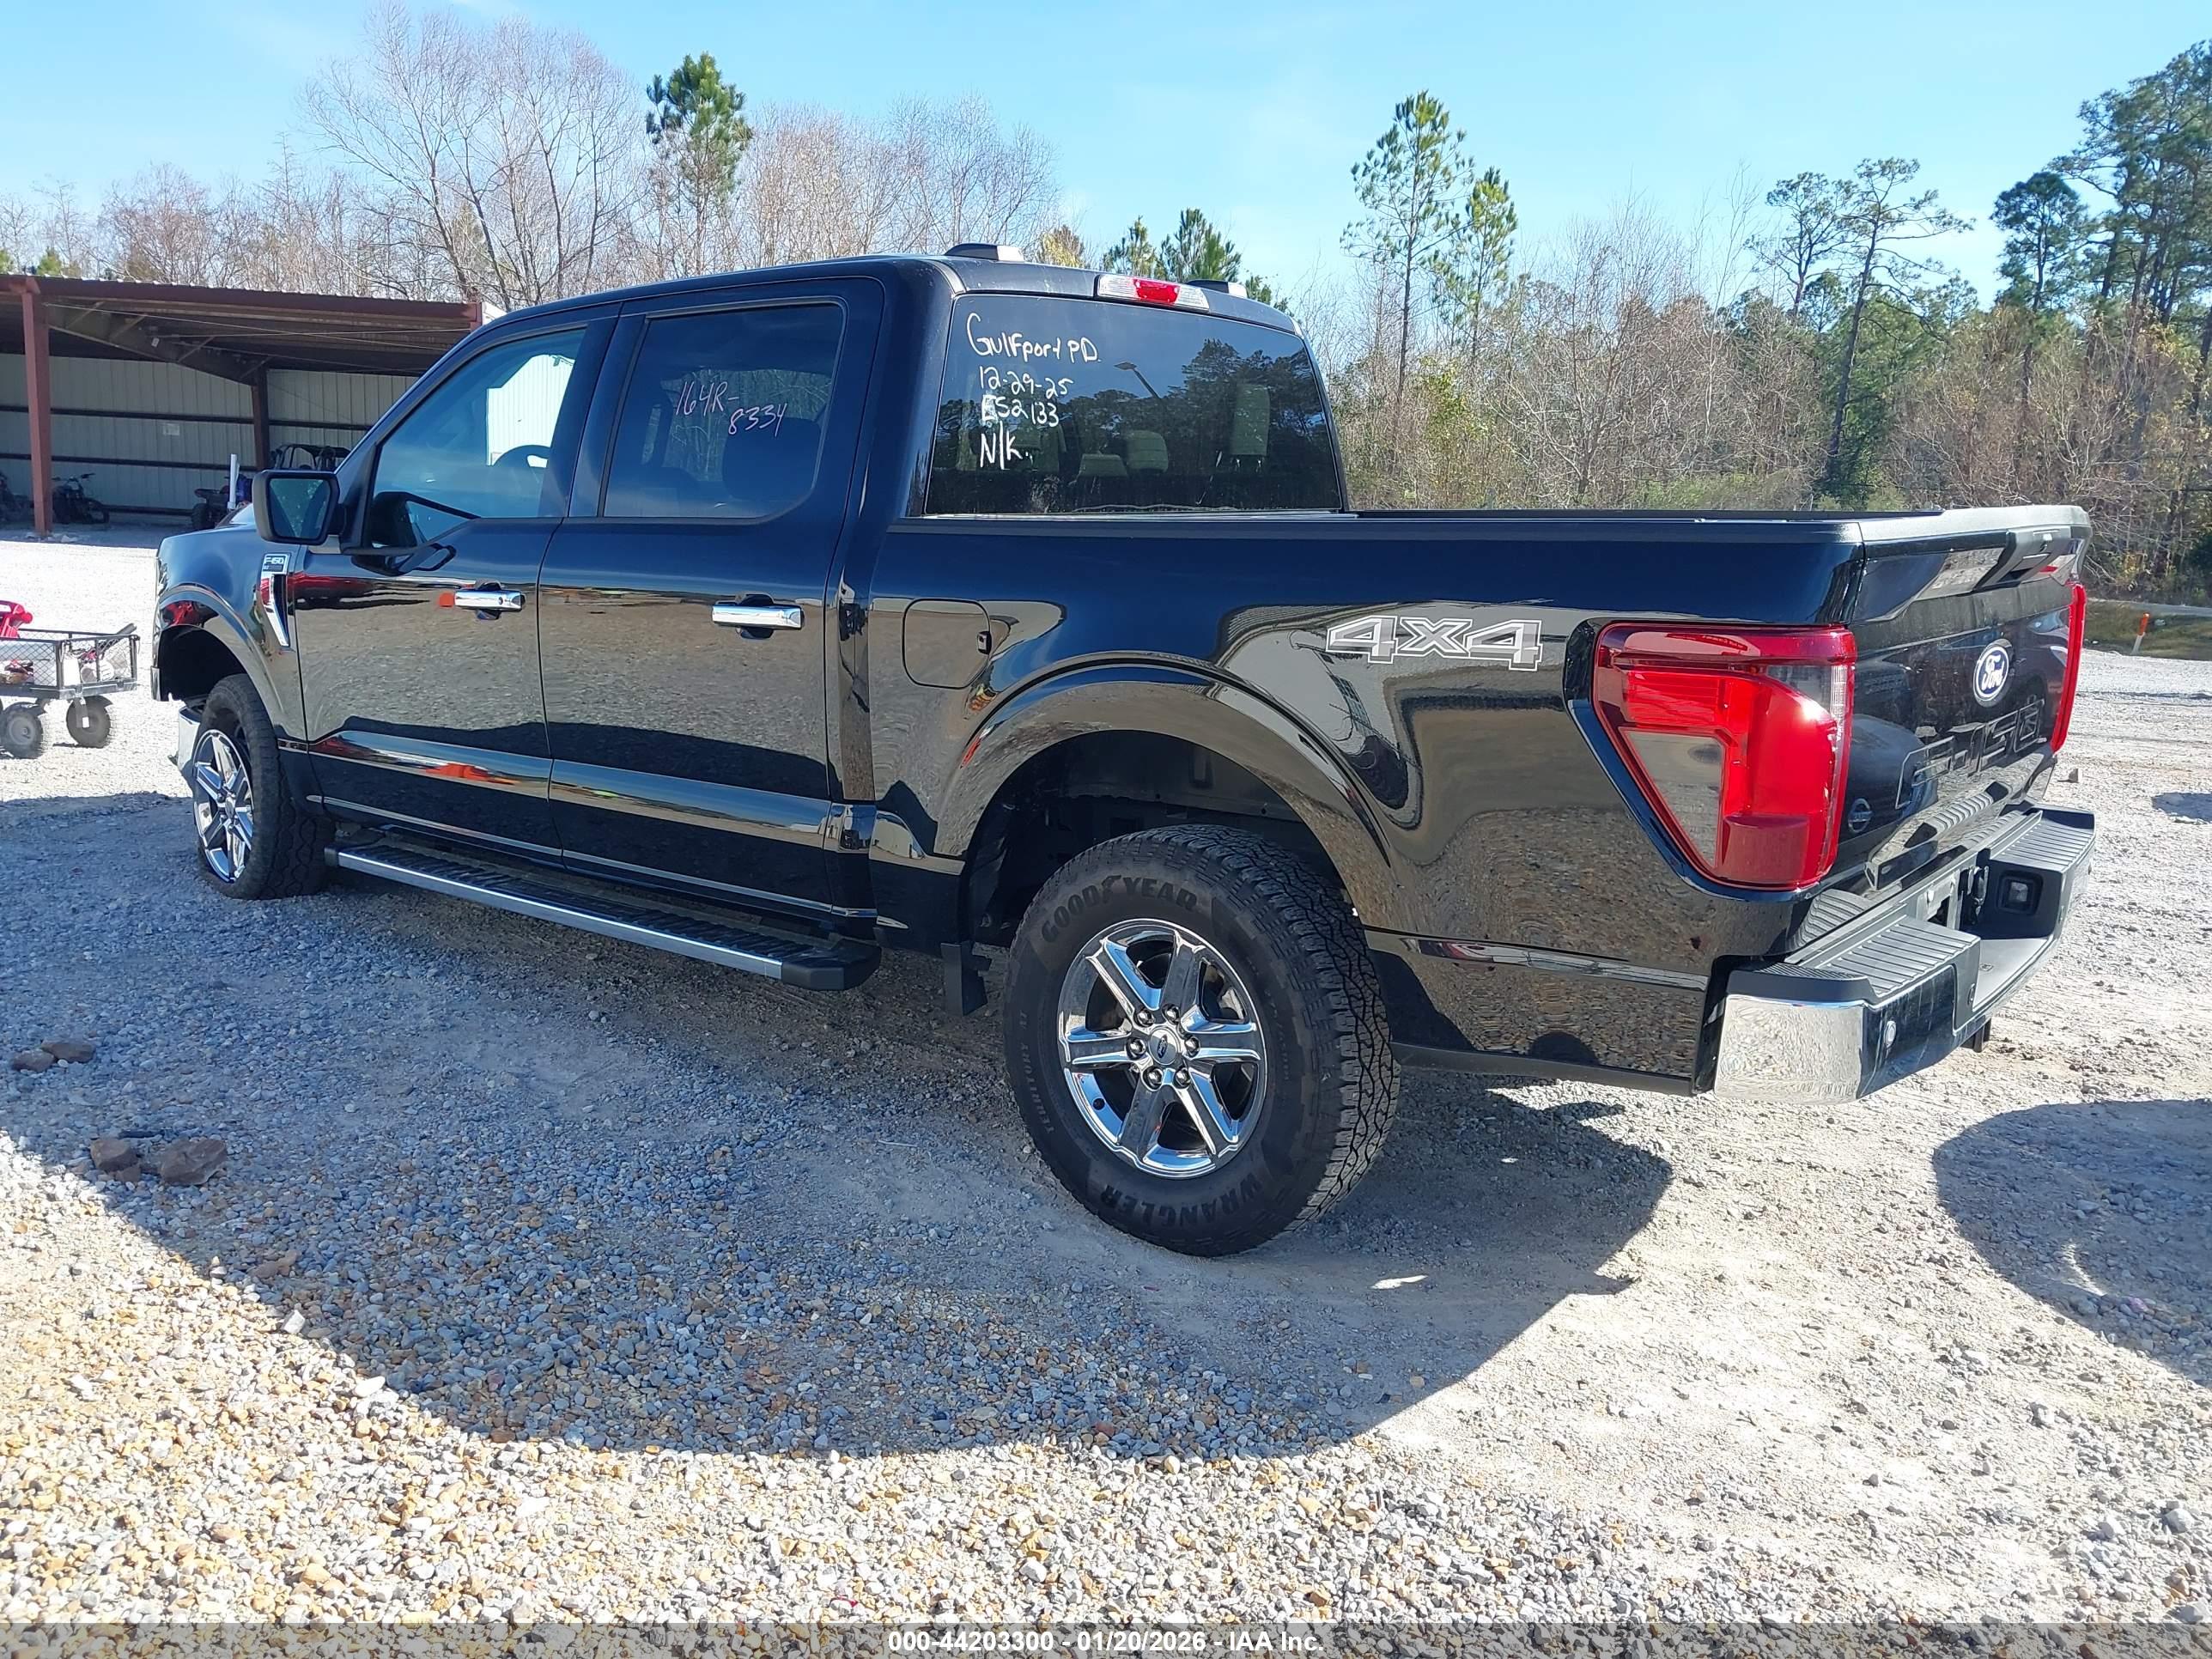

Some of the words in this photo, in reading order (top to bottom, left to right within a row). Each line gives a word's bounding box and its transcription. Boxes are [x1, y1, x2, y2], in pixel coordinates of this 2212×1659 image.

[979, 365, 1074, 399] 12-29-25
[727, 402, 788, 437] 8334
[1041, 874, 1198, 943] GOODYEAR
[1100, 1171, 1262, 1228] WRANGLER
